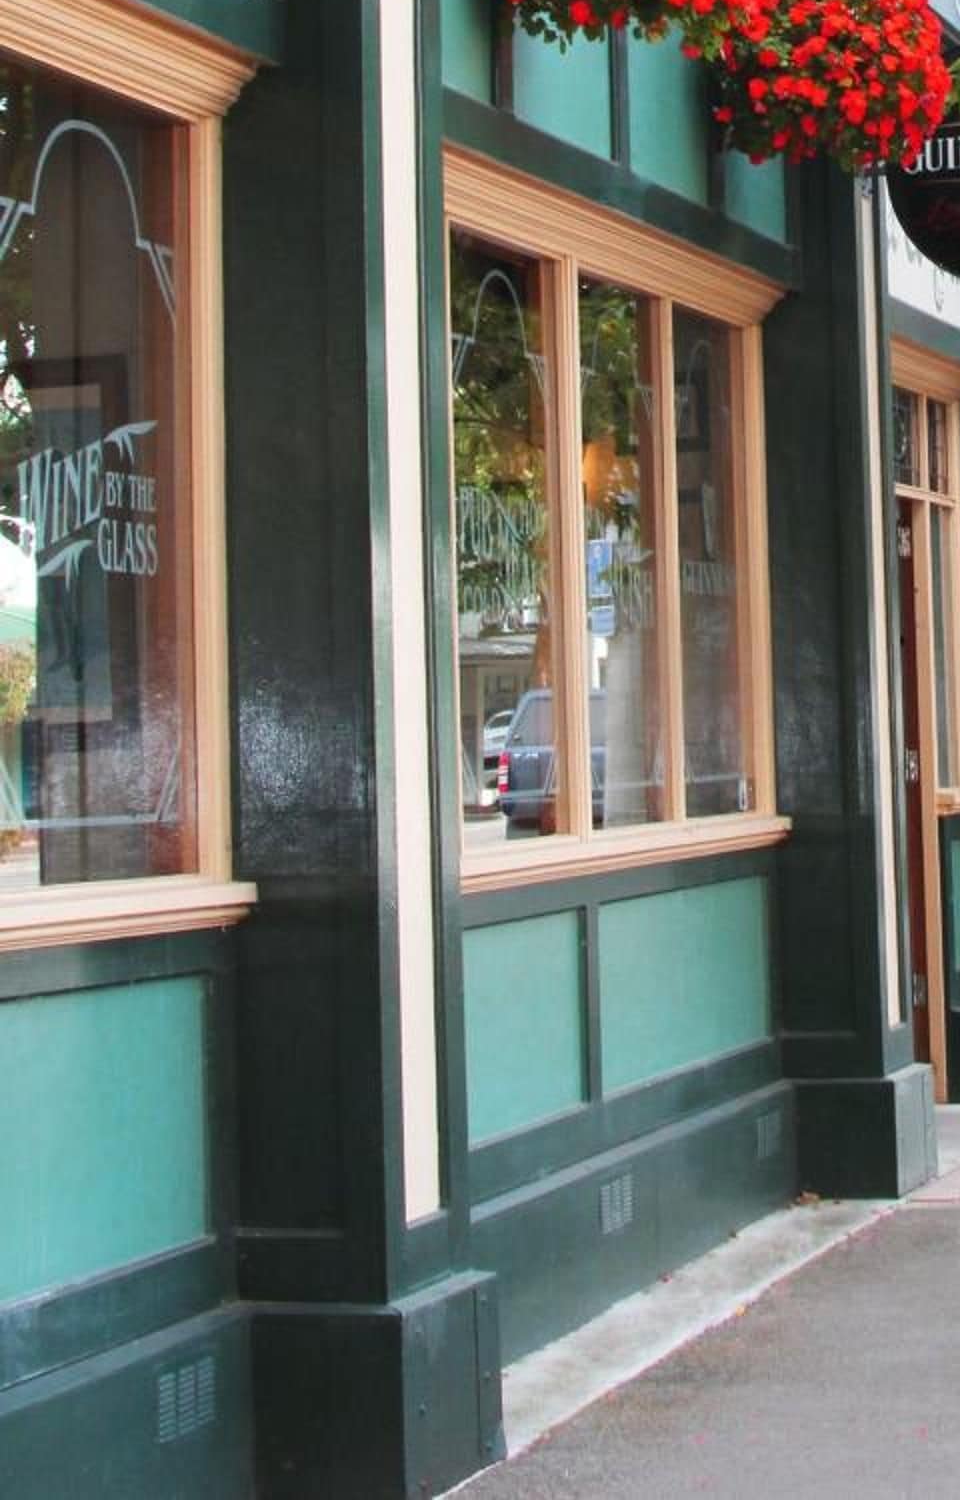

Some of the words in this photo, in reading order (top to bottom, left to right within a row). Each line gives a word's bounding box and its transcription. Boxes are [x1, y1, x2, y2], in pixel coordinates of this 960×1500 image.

[17, 439, 103, 552] WINE
[105, 470, 126, 507] BY
[128, 475, 157, 512] THE
[97, 517, 158, 577] GLASS
